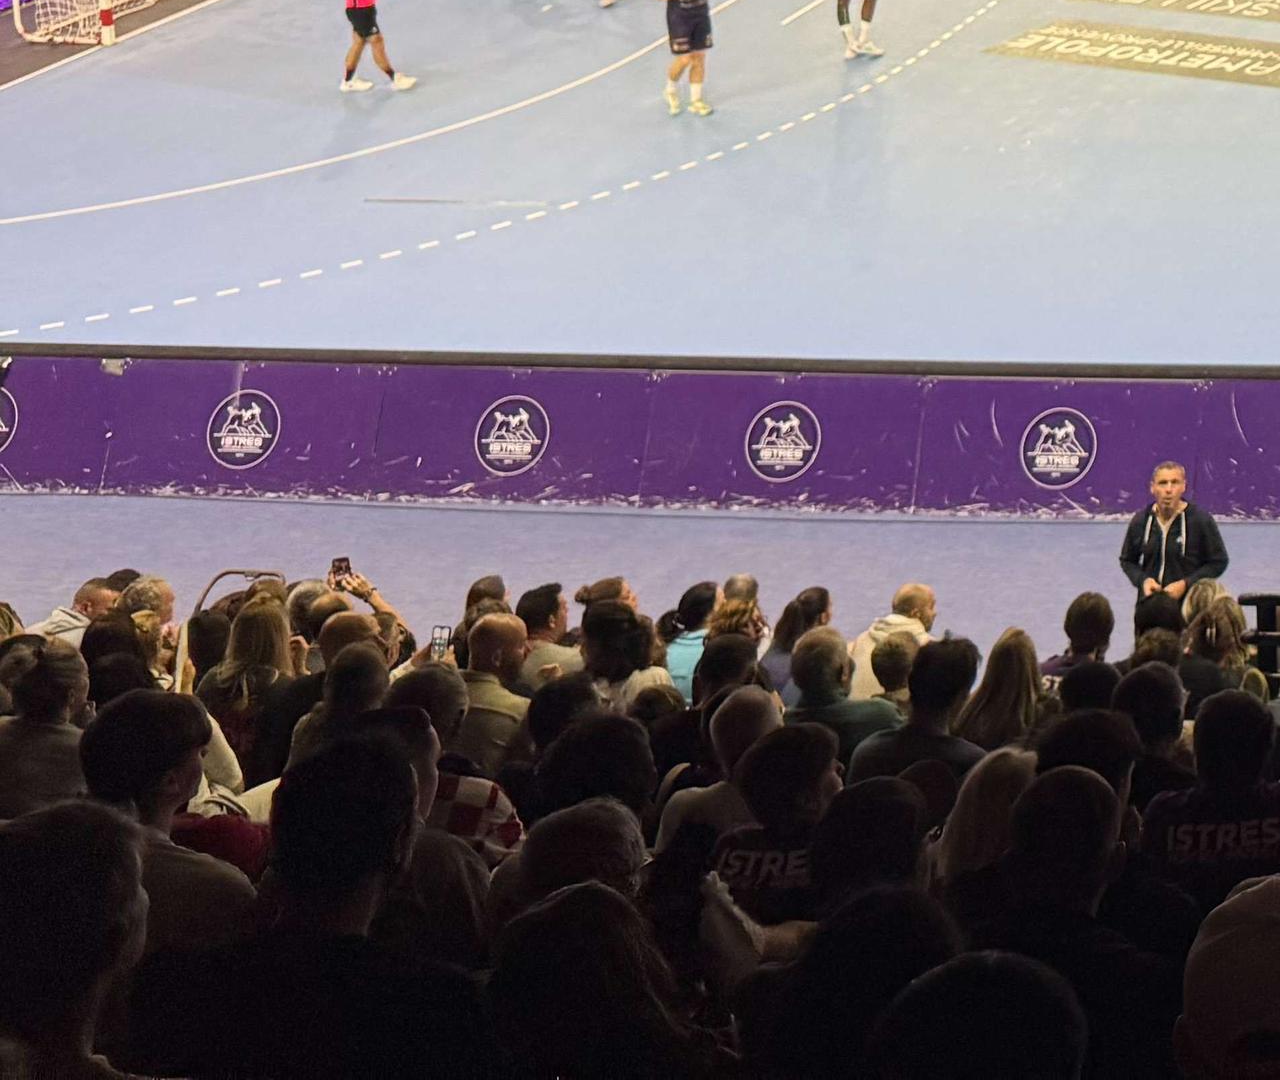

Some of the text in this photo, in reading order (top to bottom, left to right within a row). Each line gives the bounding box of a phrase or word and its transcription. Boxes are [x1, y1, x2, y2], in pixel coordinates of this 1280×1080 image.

[221, 437, 262, 447] ISTRES
[490, 442, 531, 453] ISTRES
[760, 449, 802, 460] ISTRES
[1035, 456, 1078, 466] ISTRES
[1168, 817, 1280, 852] ISTRES
[718, 848, 808, 877] ISTRE
